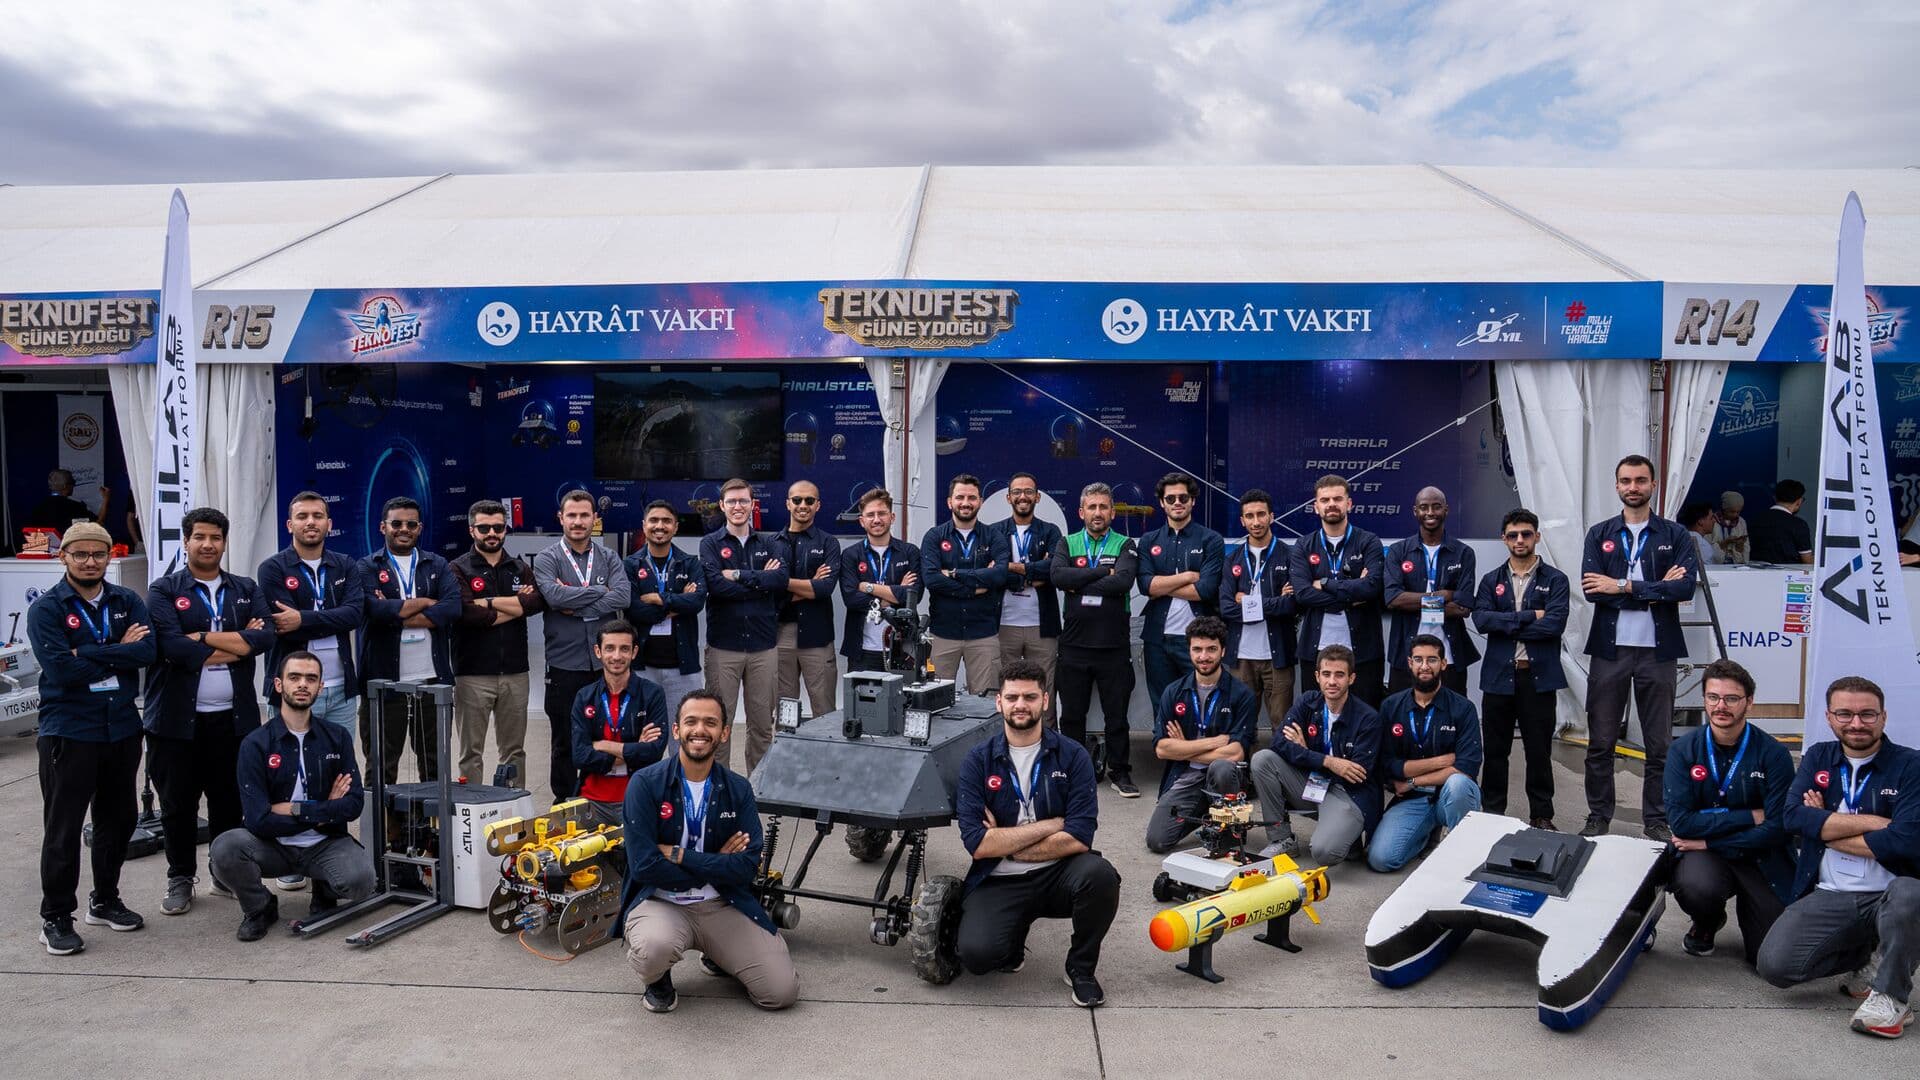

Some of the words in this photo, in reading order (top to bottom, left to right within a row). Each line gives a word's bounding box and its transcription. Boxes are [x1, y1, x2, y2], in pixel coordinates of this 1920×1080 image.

[0, 298, 153, 328] EKNOFEST
[826, 289, 1014, 317] TEKNOFEST
[203, 305, 275, 349] R15
[528, 304, 644, 334] HAYRÂT
[649, 308, 736, 332] VAKFI
[858, 319, 987, 338] GÜNEYDOĞU
[1157, 303, 1278, 332] HAYRÂT
[1284, 309, 1372, 332] VAKFI
[1675, 298, 1760, 346] R14
[17, 327, 131, 347] GÜNEYDOĞU
[351, 321, 423, 353] TEKNOFEST
[1853, 328, 1872, 476] PLATFORMU
[1320, 439, 1388, 448] TASARLA
[1305, 460, 1401, 470] PROTOTİPLE
[1363, 483, 1382, 492] ET
[1368, 504, 1401, 516] TAŞI
[4, 703, 20, 716] YTG
